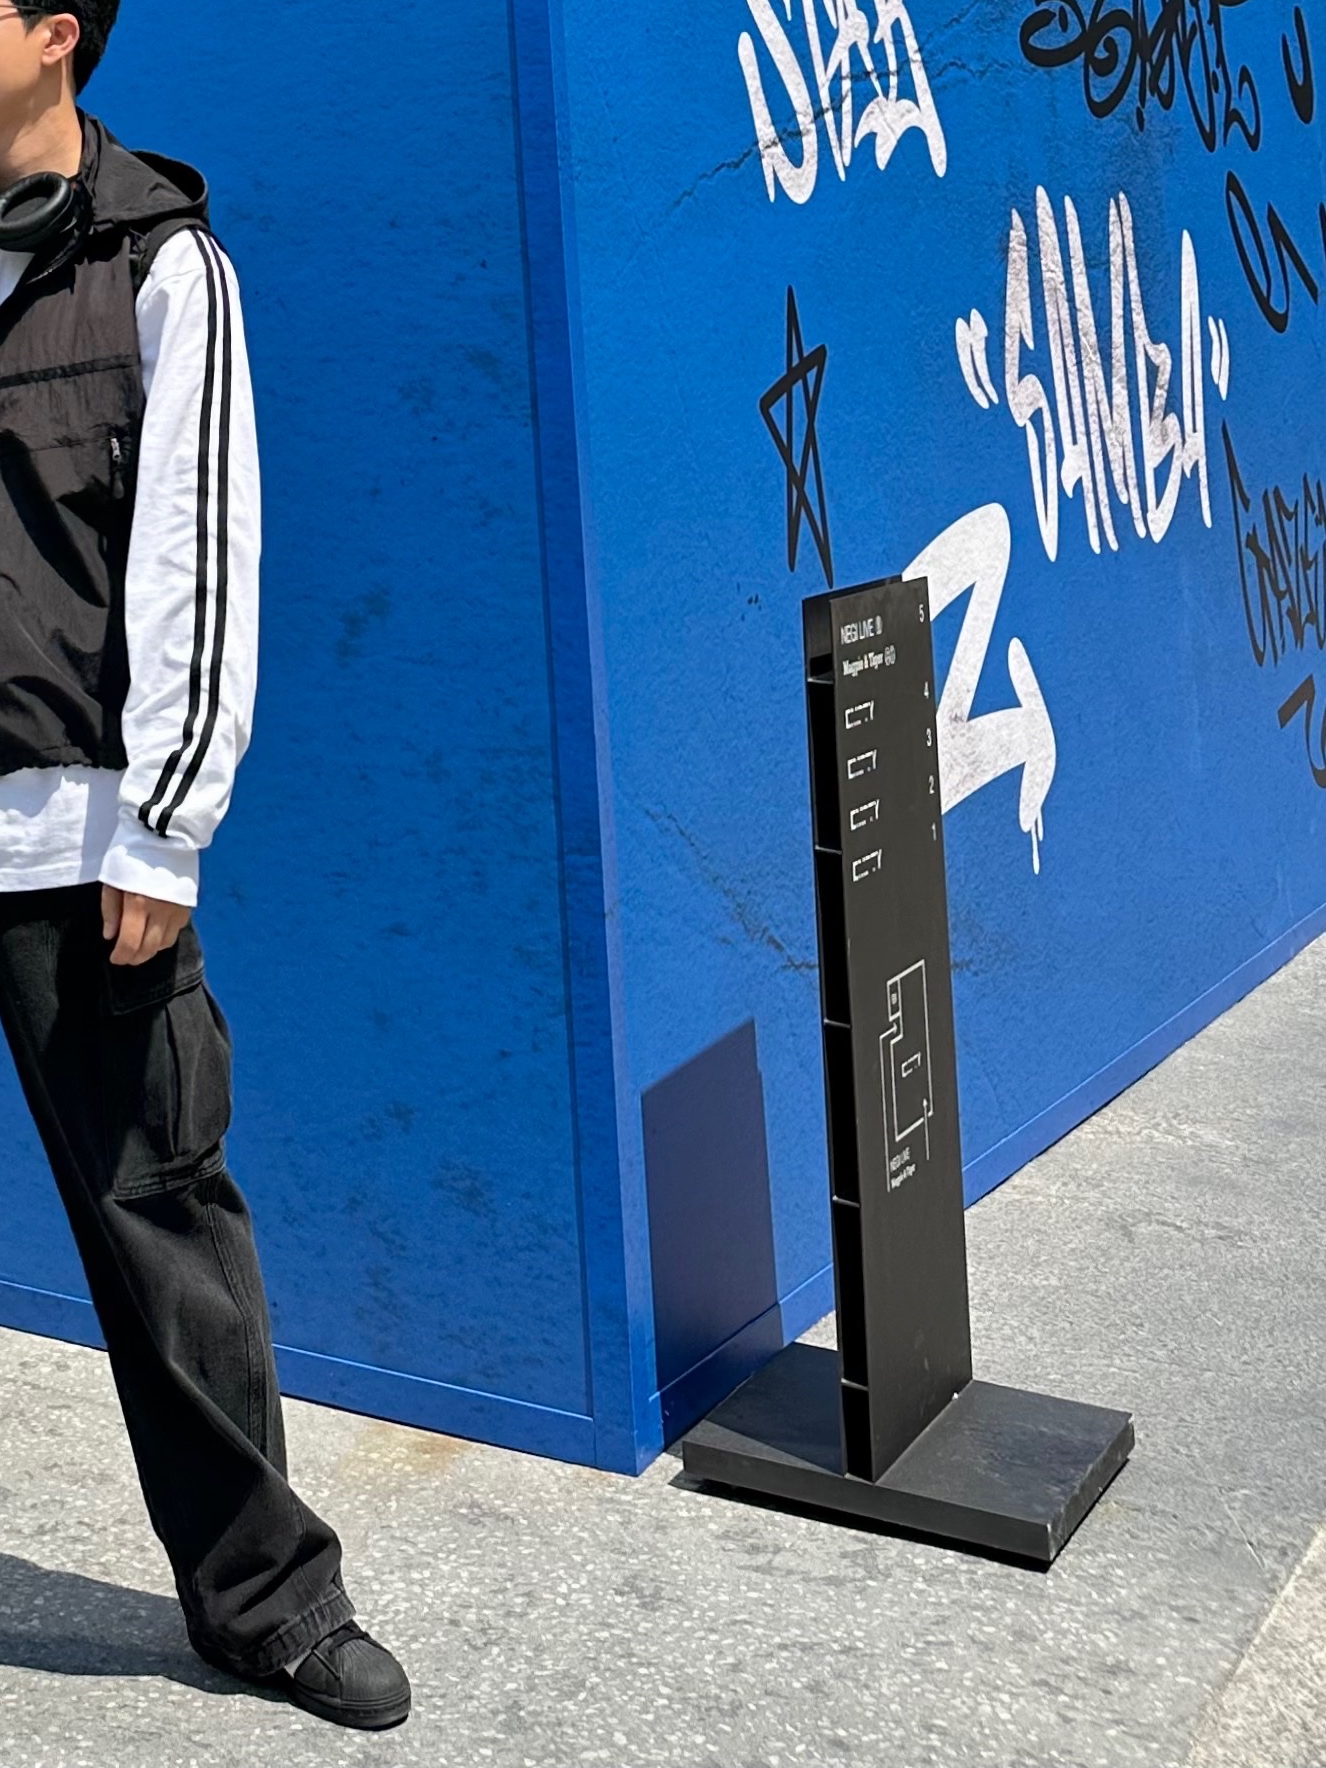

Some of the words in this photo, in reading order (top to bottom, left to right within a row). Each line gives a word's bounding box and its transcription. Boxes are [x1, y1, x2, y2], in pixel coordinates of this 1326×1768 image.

[918, 603, 925, 623] 5
[923, 681, 930, 699] 4
[926, 728, 933, 747] 3
[929, 775, 935, 795] 2
[931, 822, 937, 841] 1
